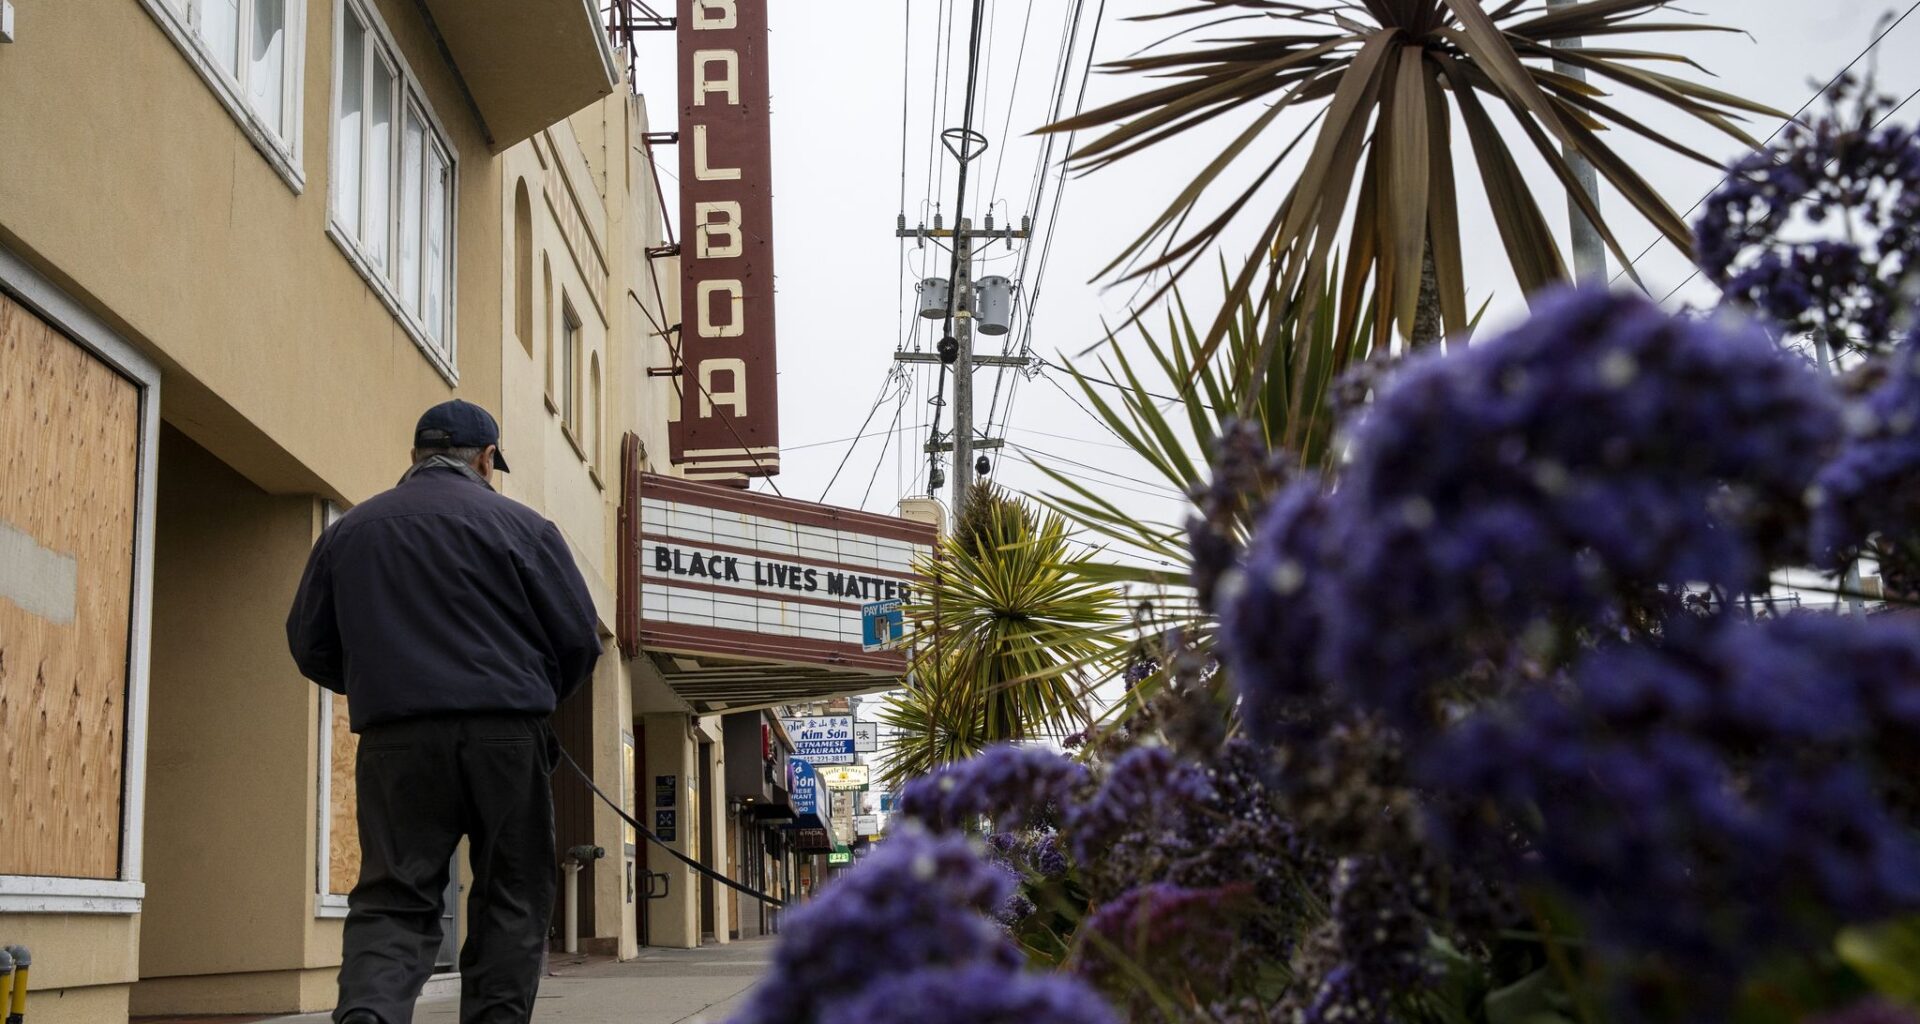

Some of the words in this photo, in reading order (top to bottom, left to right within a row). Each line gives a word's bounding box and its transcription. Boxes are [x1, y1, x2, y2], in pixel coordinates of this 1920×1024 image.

[692, 0, 747, 418] BALBOA
[655, 546, 740, 582] BLACK
[755, 561, 818, 592] LIVES
[828, 571, 912, 605] MATTER
[864, 605, 878, 616] PAY
[801, 729, 823, 740] Kim
[796, 740, 846, 749] IETNAMESE
[792, 746, 847, 755] ESTAURANT
